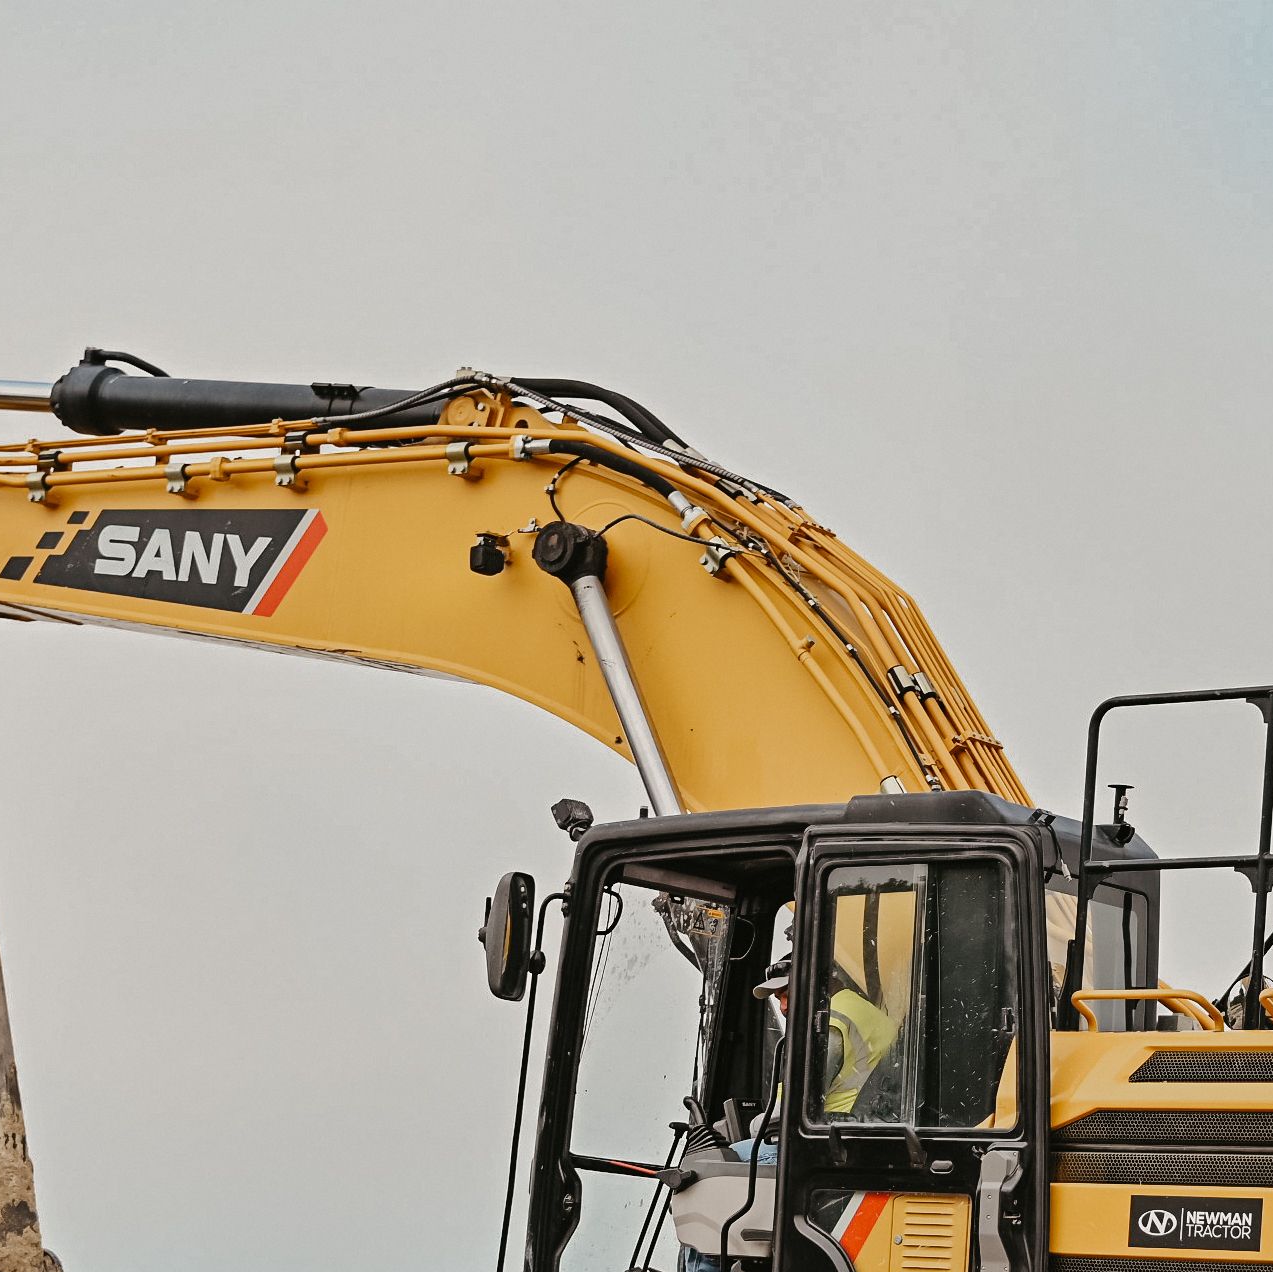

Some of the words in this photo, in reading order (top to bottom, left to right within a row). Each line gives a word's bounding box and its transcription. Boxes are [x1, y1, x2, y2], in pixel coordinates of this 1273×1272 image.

[94, 524, 273, 588] SANY
[1186, 1211, 1253, 1226] NEWMAN
[1186, 1223, 1251, 1239] TRACTOR
